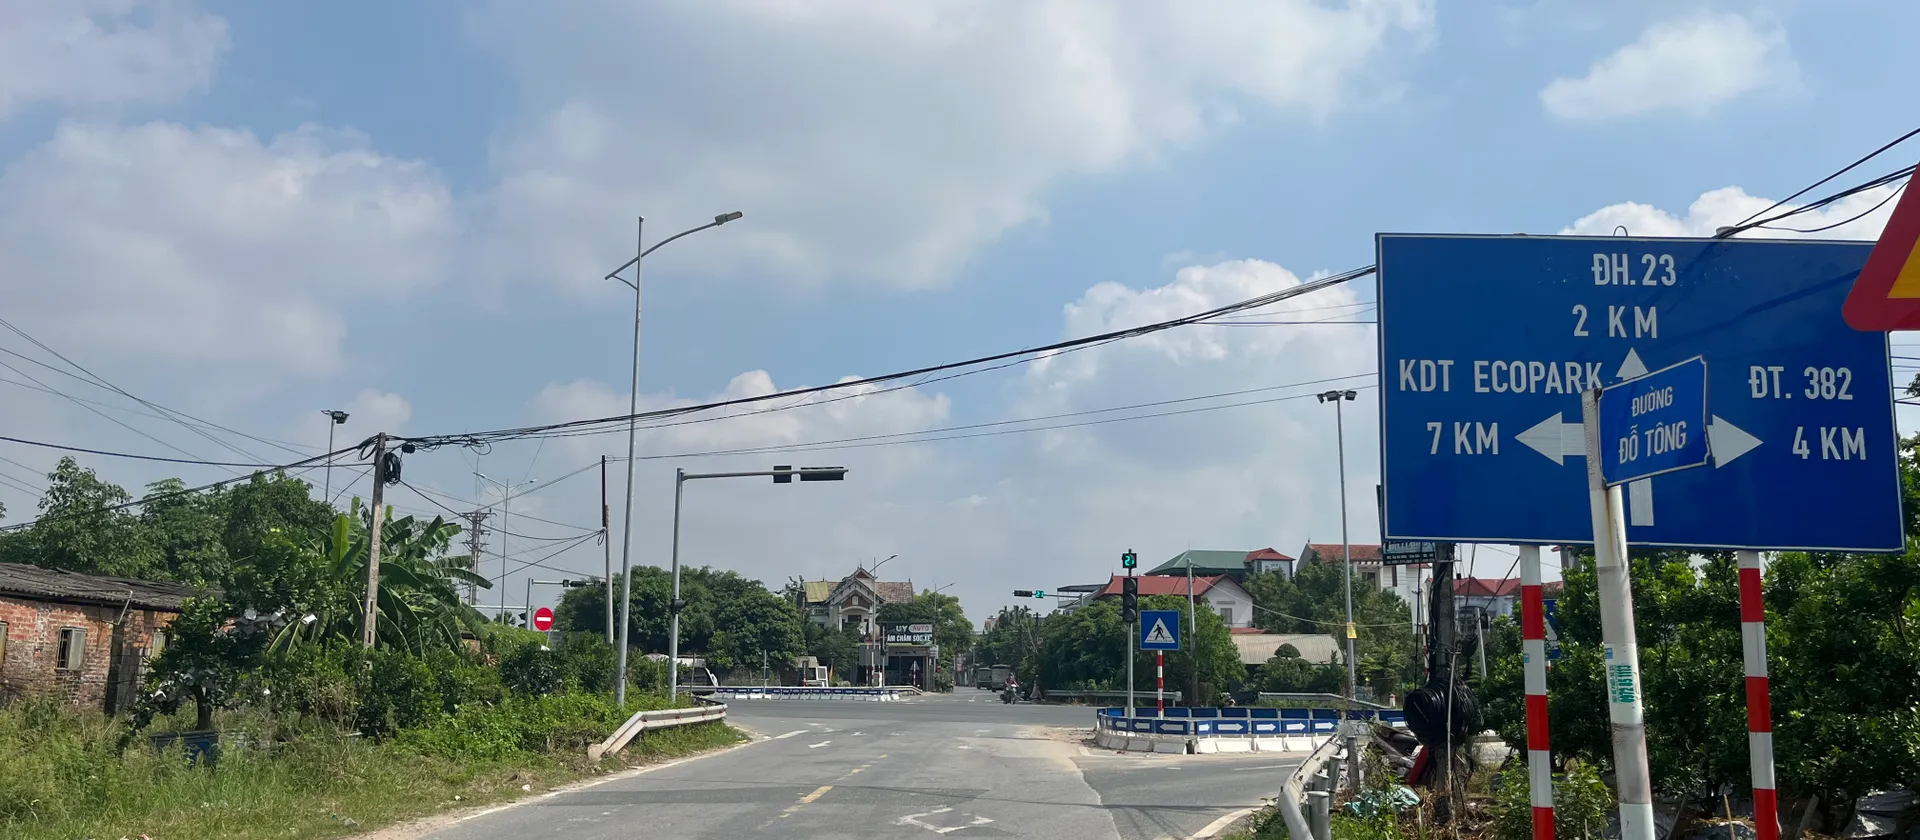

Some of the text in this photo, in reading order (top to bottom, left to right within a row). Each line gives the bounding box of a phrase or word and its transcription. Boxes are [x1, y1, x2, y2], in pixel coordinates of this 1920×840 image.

[1572, 304, 1658, 338] 2 KM
[1399, 359, 1603, 395] KDT ECOPARK
[1748, 366, 1853, 400] ĐT. 382
[1631, 386, 1673, 418] ĐƯỜNG
[1427, 422, 1499, 455] 7 KM
[1618, 420, 1688, 465] ĐỖ TÔNG
[1792, 427, 1866, 461] 4 KM
